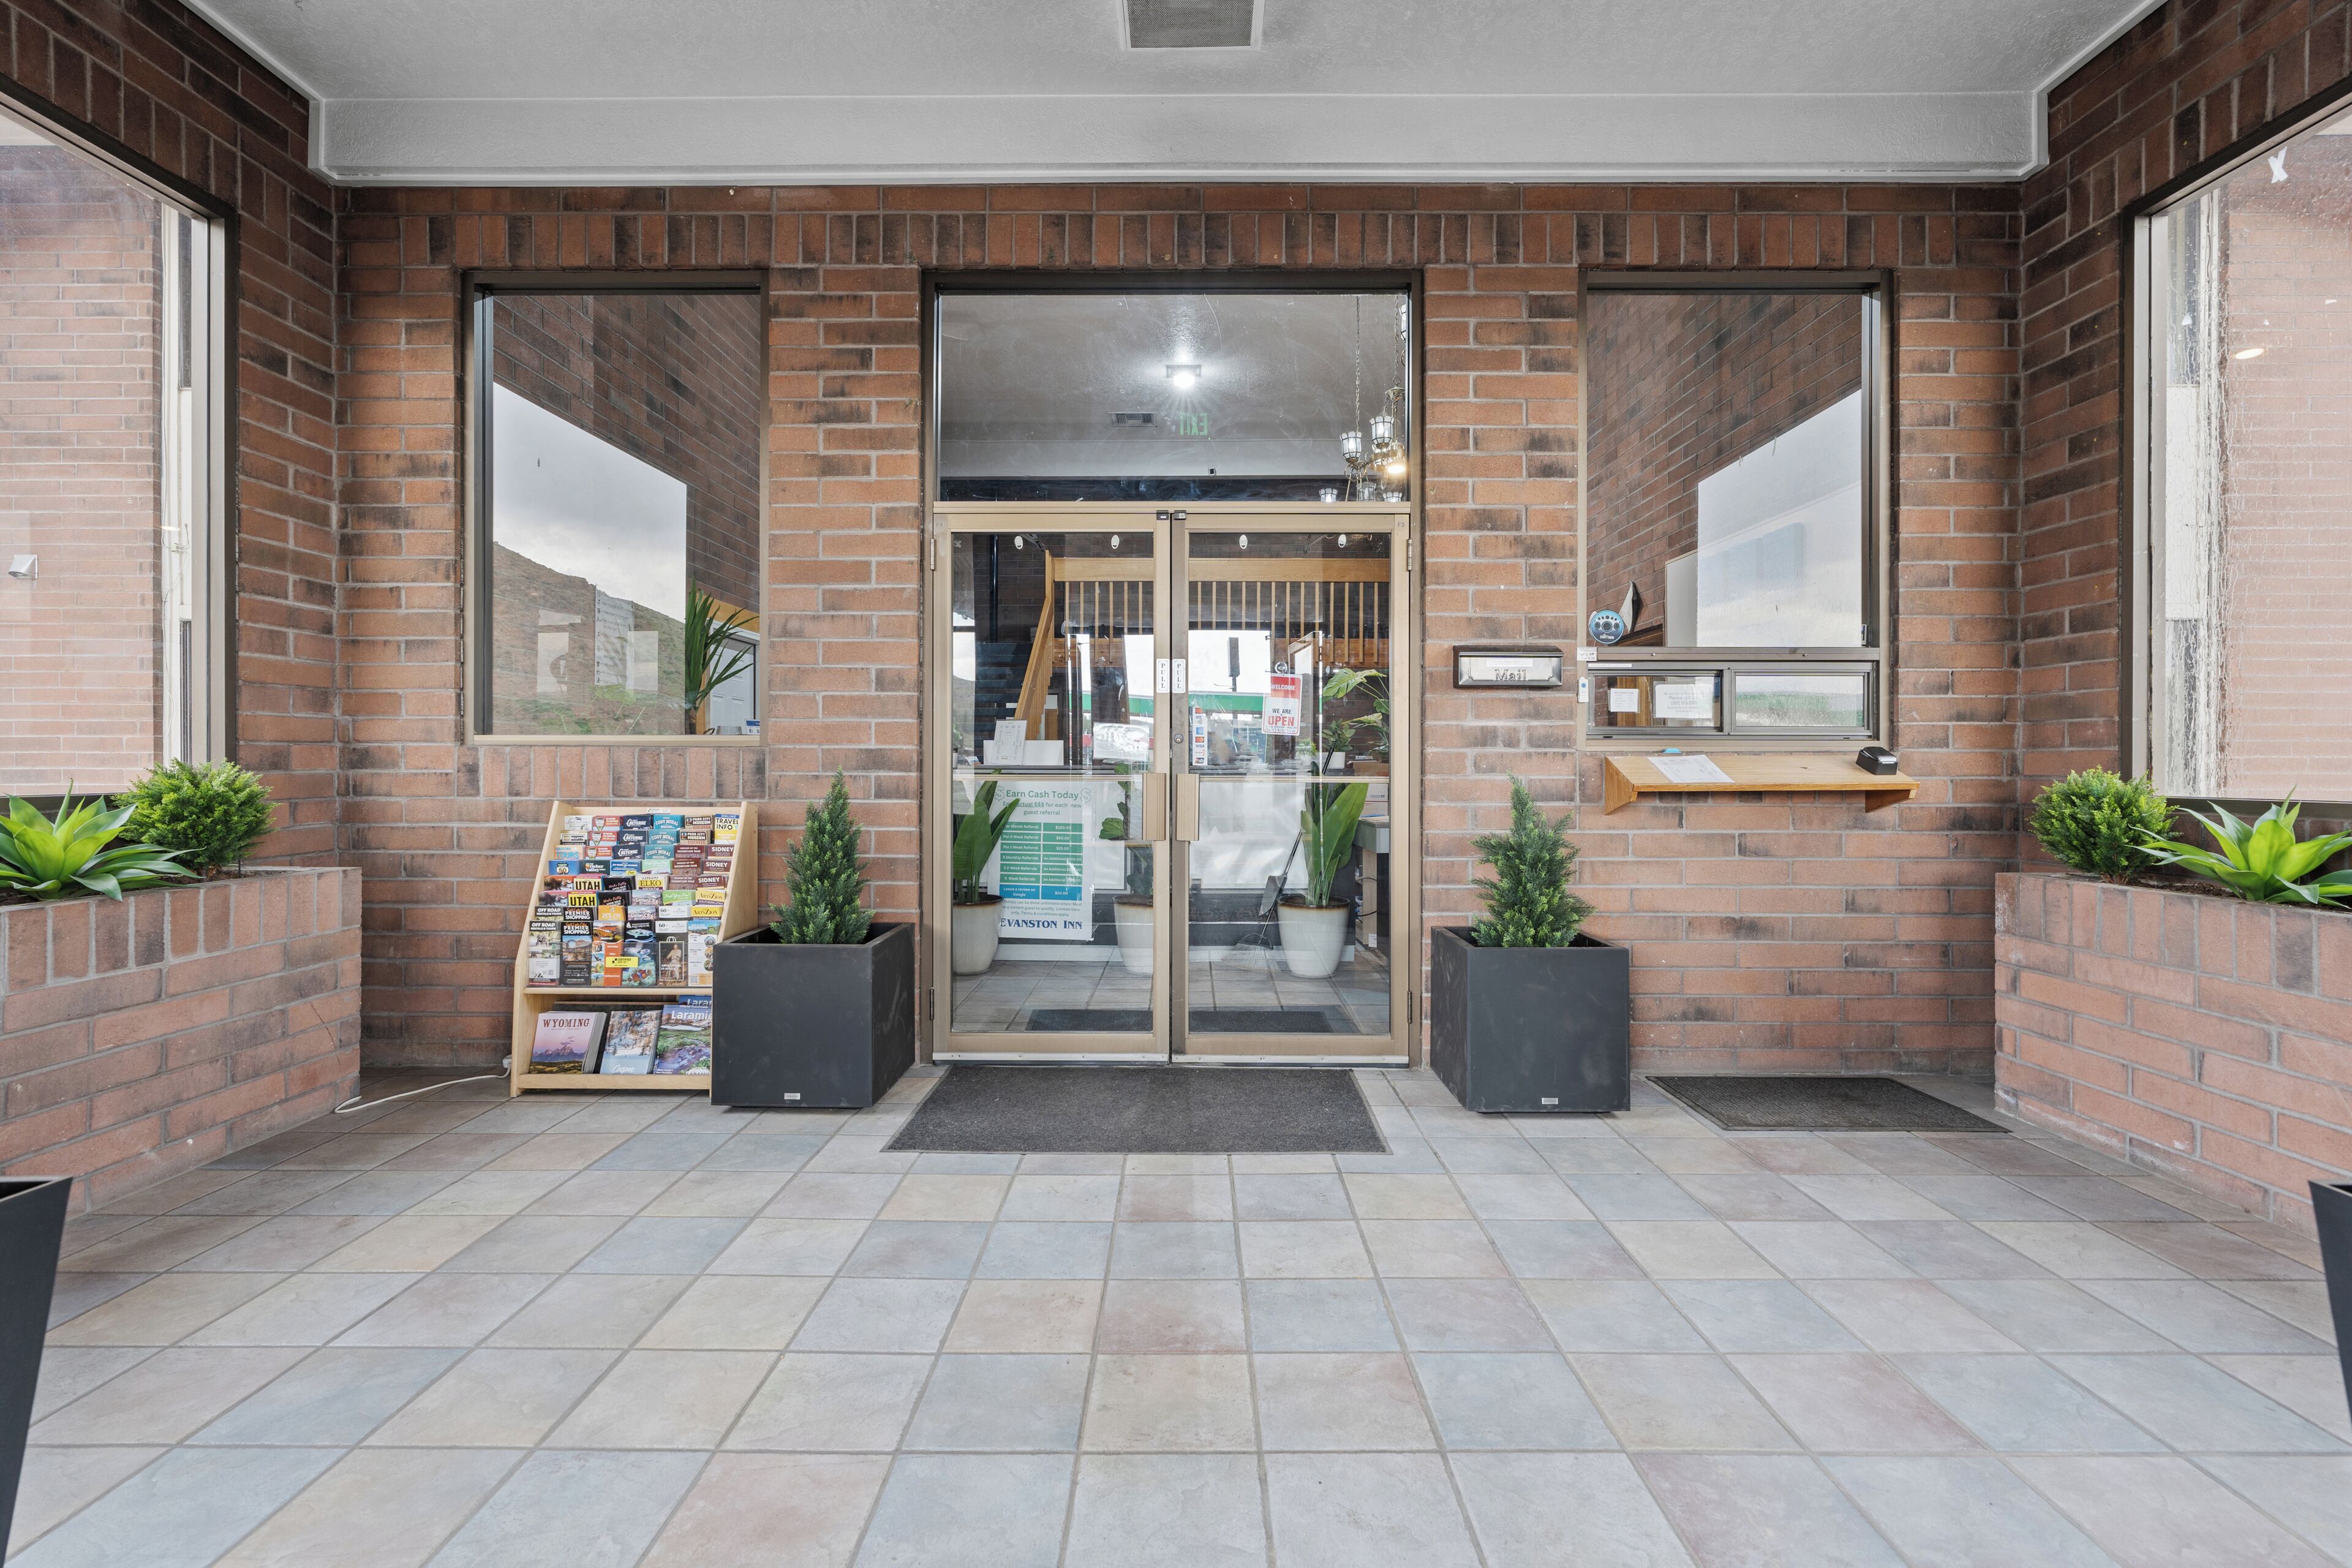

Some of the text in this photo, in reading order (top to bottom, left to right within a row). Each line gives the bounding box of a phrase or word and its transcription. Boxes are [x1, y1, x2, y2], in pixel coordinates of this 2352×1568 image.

[1494, 669, 1526, 682] Mail
[1268, 715, 1294, 726] OPEN
[1052, 791, 1079, 801] Today
[576, 881, 600, 890] UTAH
[570, 896, 595, 906] UTAH
[1000, 918, 1082, 930] EVANSTON INN
[543, 1018, 590, 1028] WYOMING
